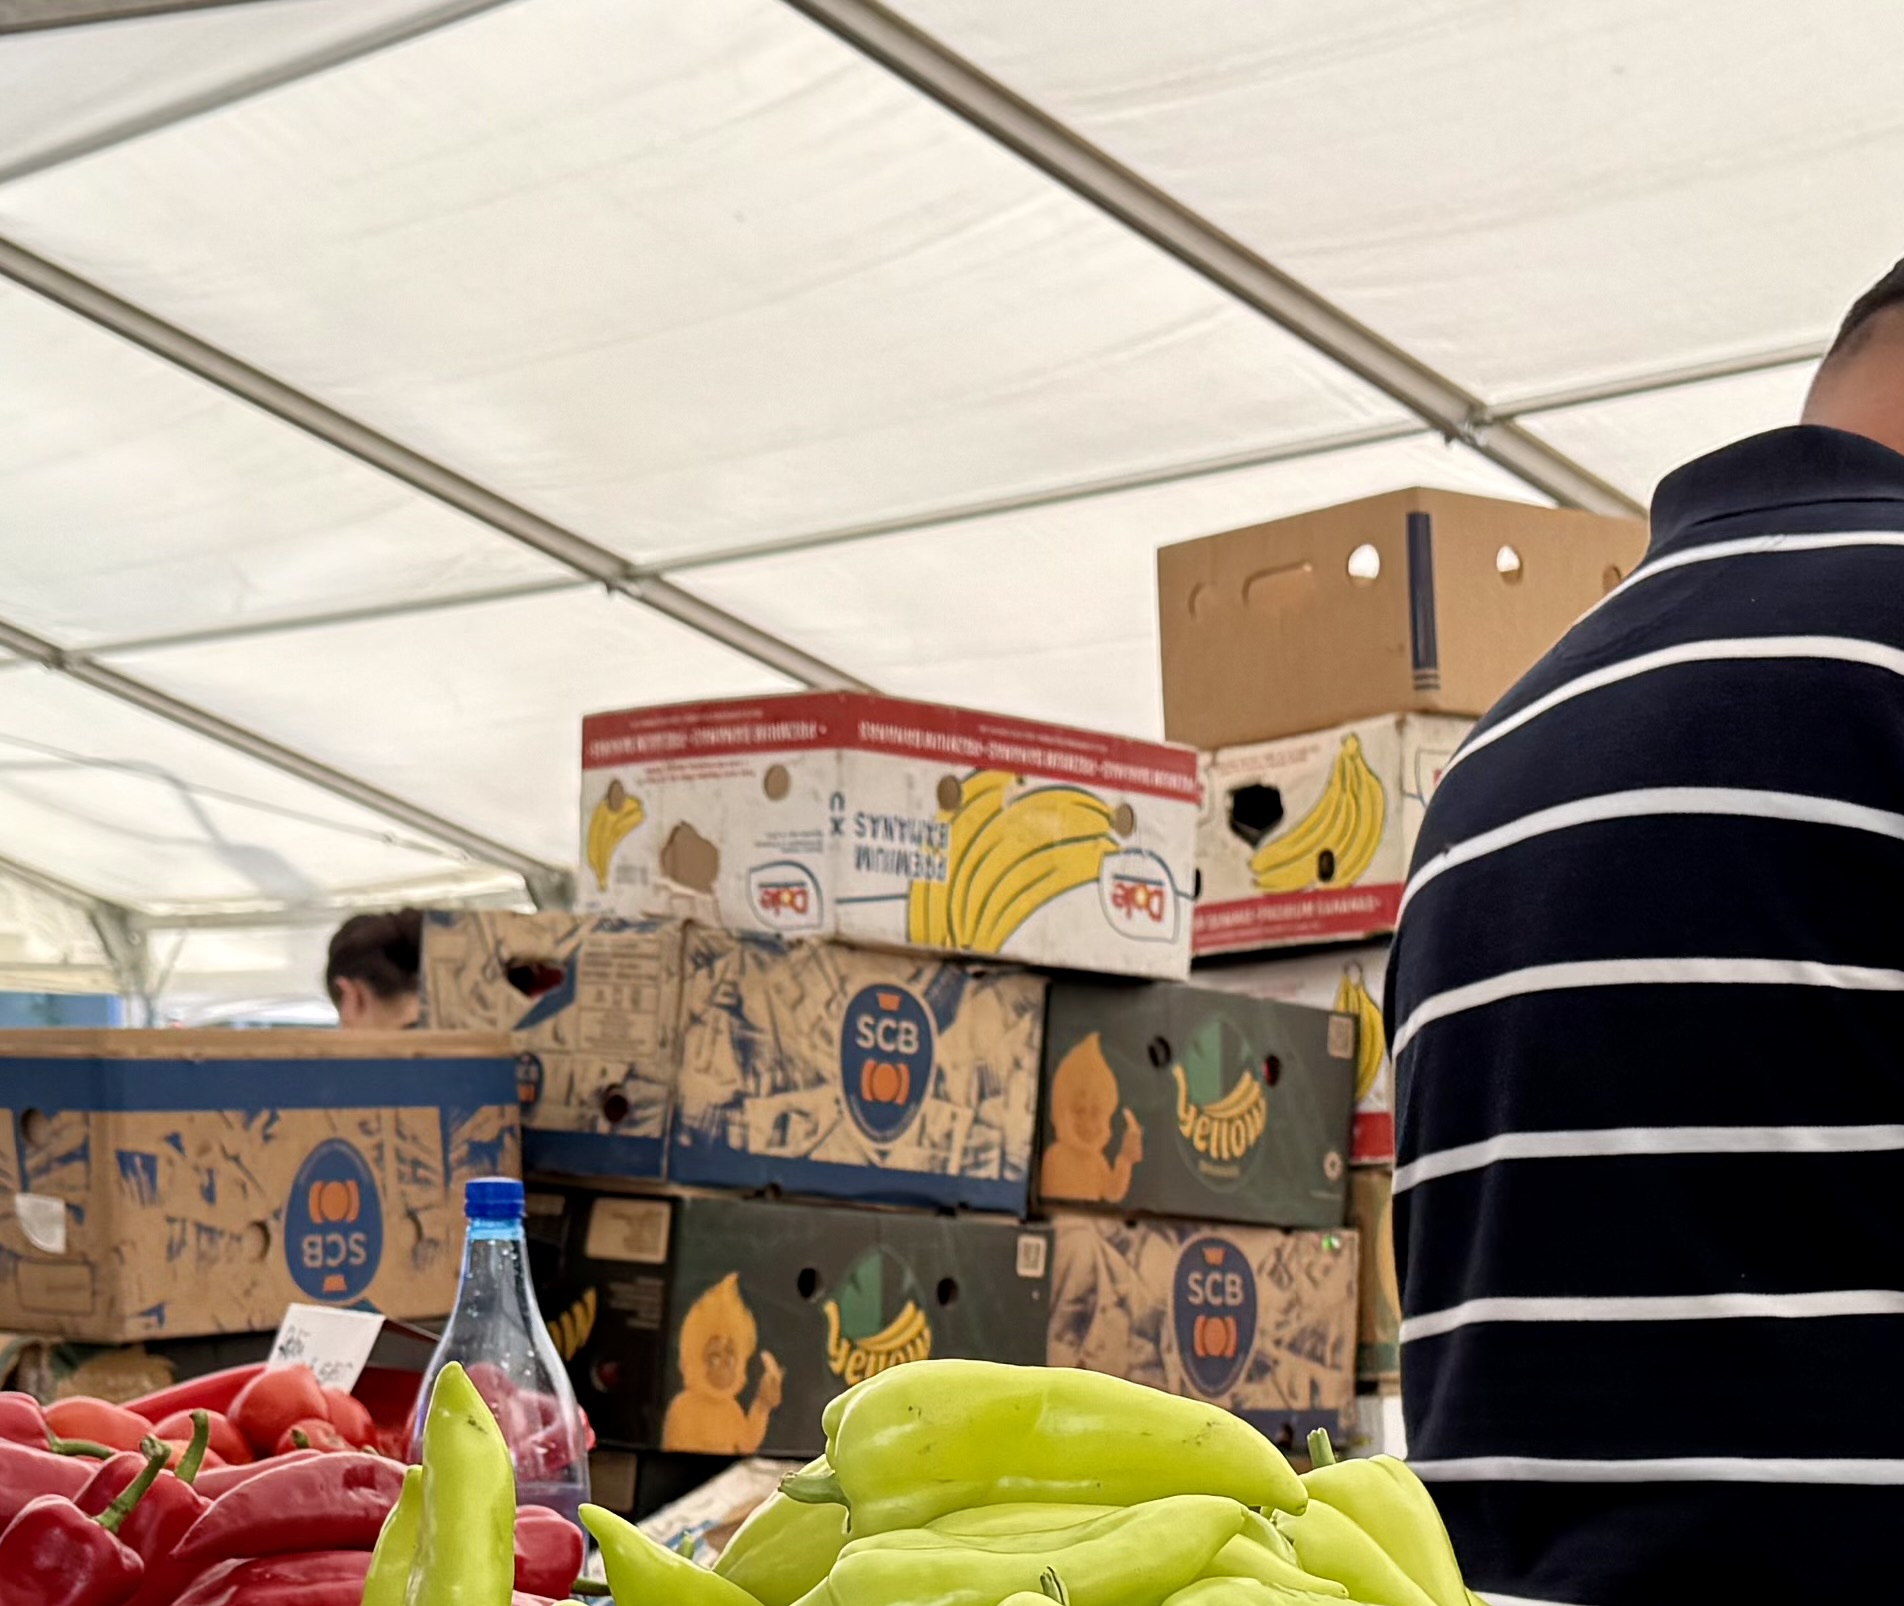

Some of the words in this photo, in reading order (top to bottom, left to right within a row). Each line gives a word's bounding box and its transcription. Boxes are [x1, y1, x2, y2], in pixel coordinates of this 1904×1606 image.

[854, 811, 949, 849] BANANAS
[855, 845, 948, 881] PREMIUM
[759, 887, 809, 917] Dole
[1111, 882, 1165, 923] Dole
[855, 1014, 920, 1055] SCB
[302, 1231, 368, 1269] SCB
[1187, 1270, 1245, 1307] SCB
